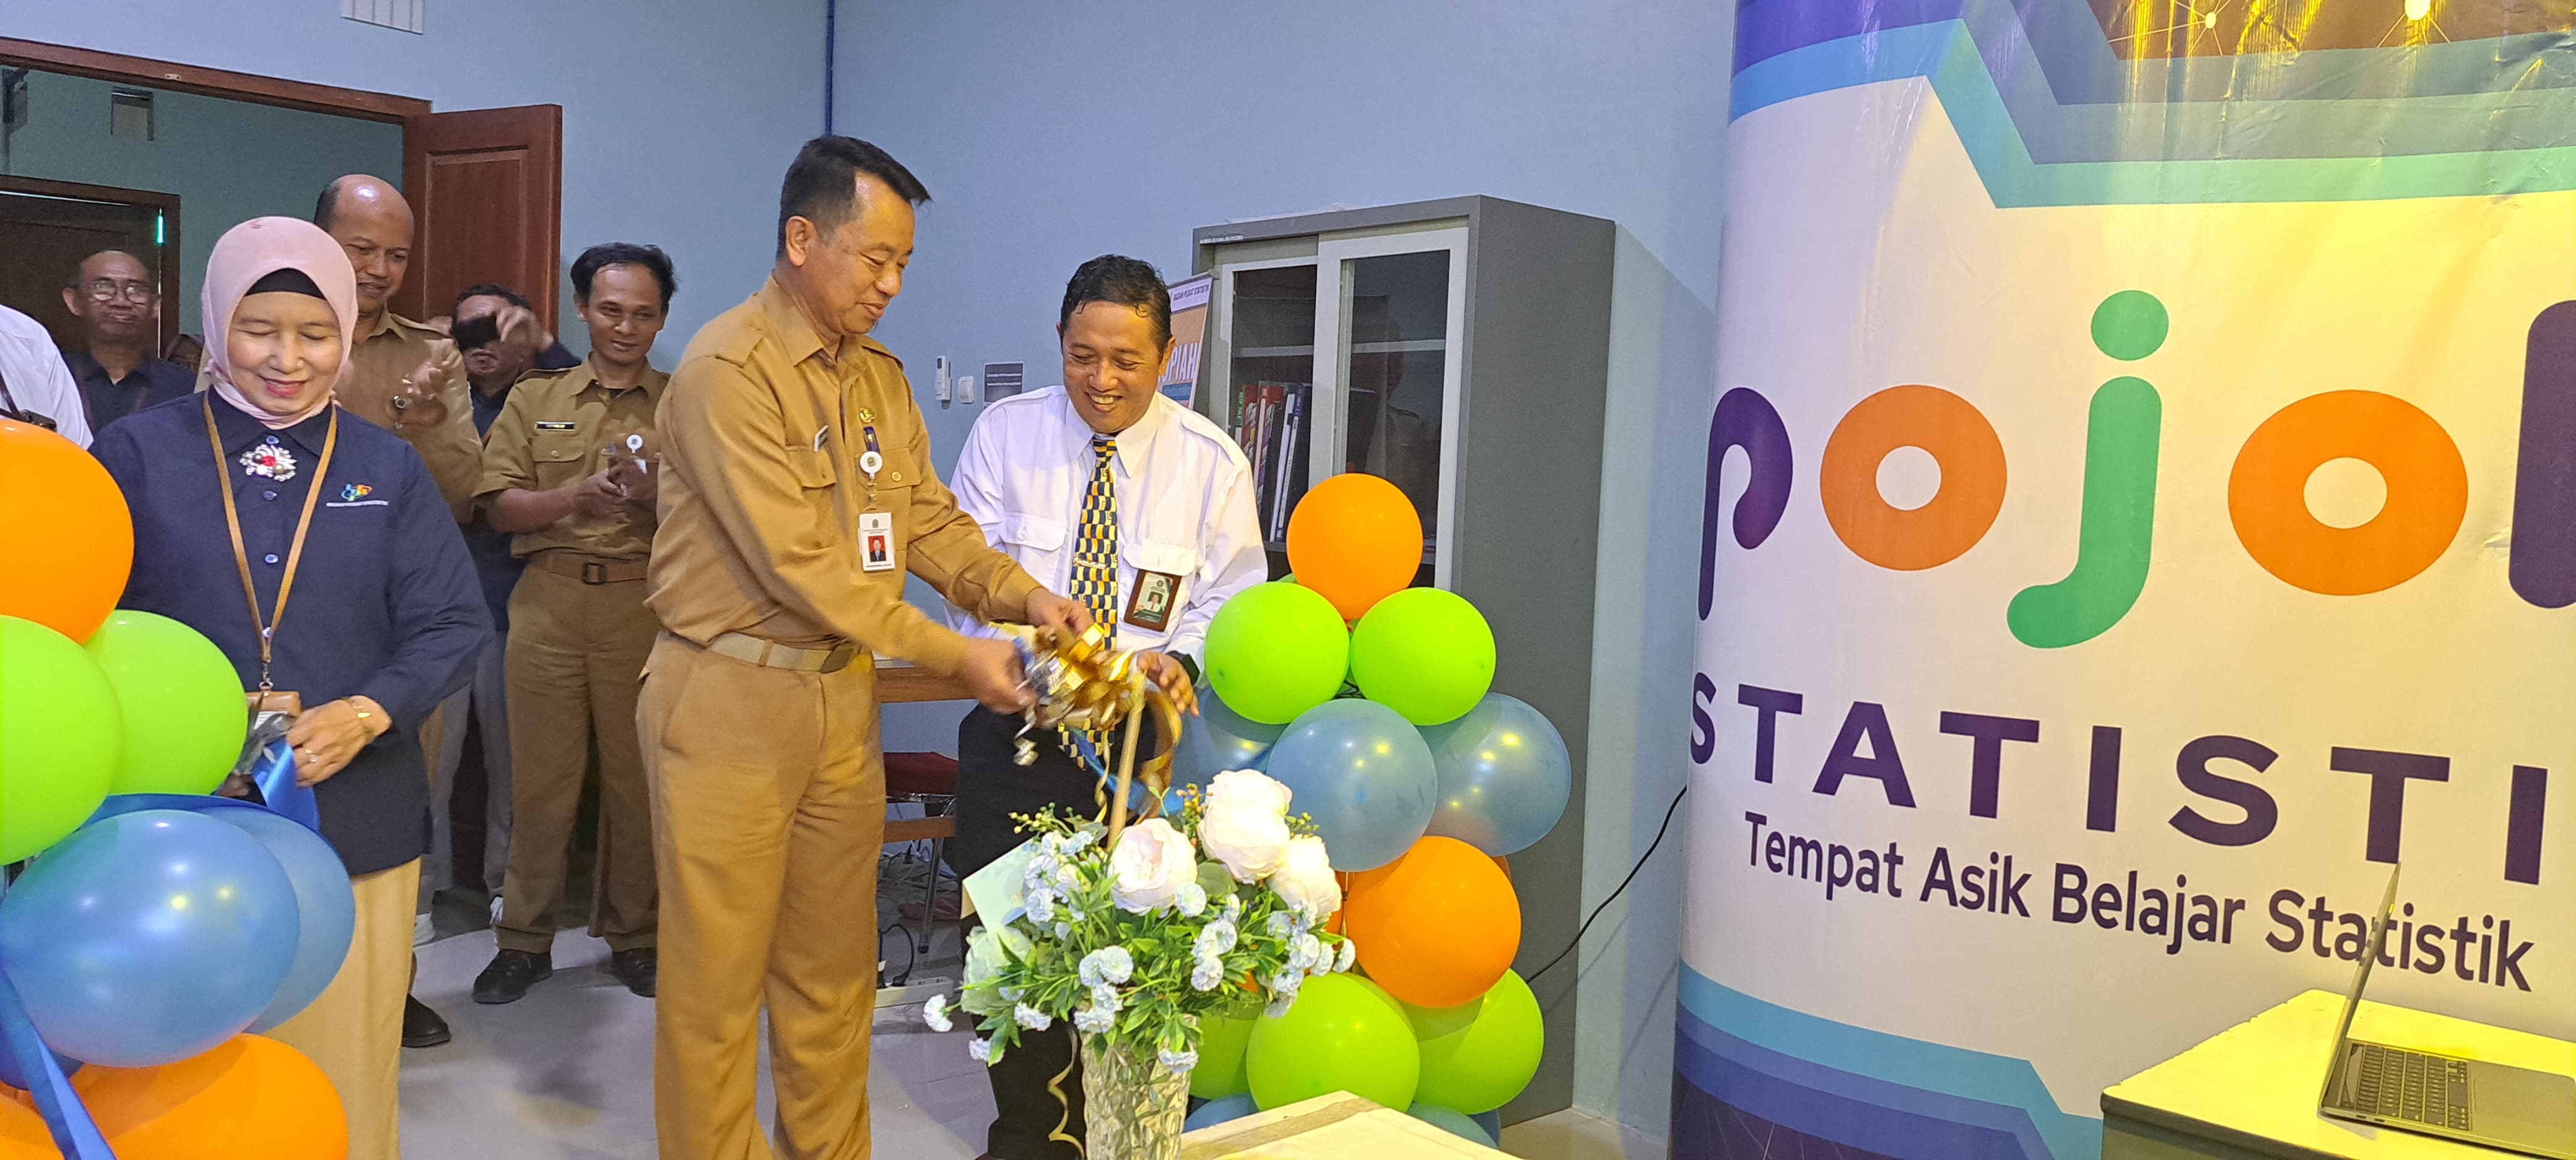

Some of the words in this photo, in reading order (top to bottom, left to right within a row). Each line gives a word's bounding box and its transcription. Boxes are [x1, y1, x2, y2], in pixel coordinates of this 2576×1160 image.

[1745, 811, 1904, 901] Tempat
[1920, 846, 2032, 917] Asik
[2052, 862, 2246, 954] Belajar
[2265, 889, 2535, 992] Statistik
